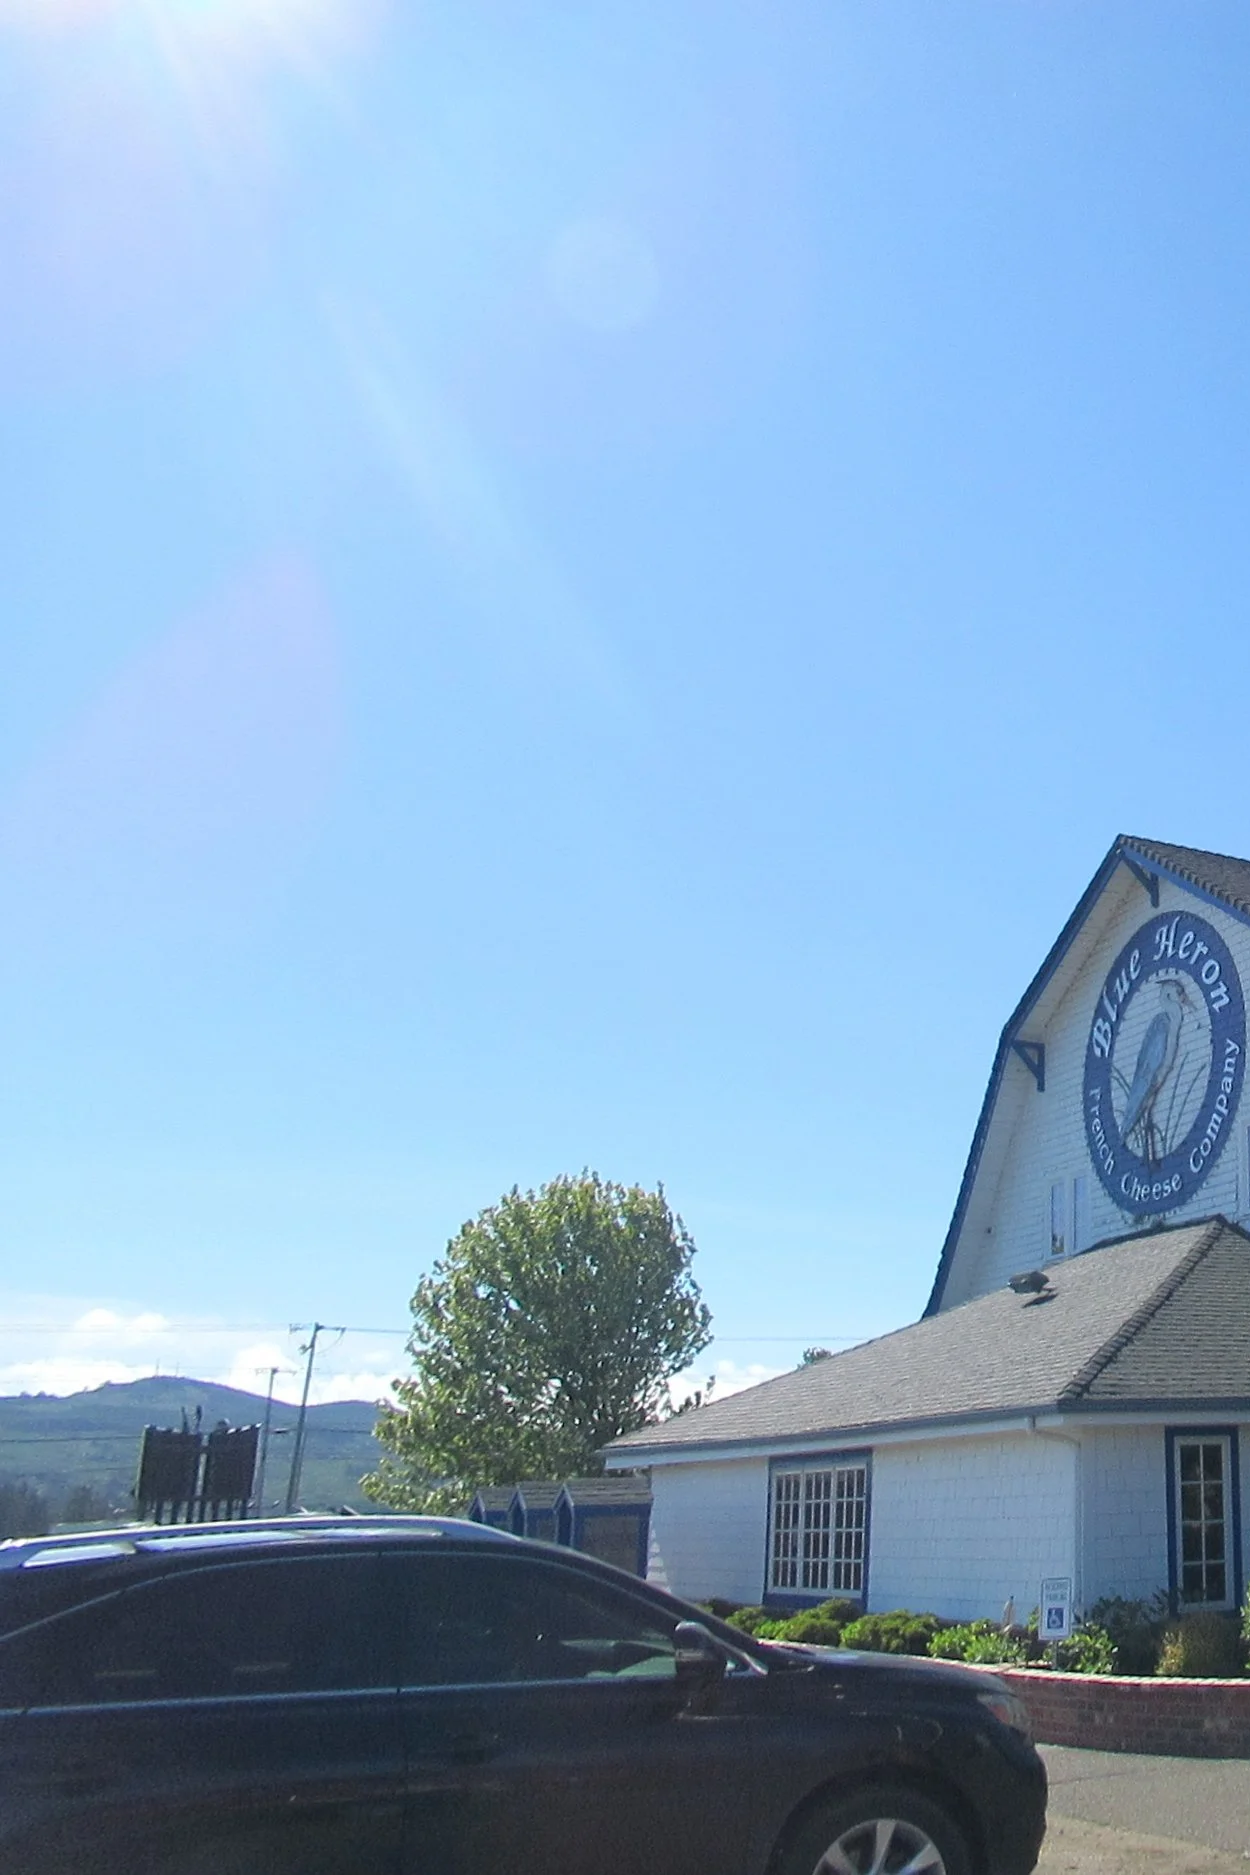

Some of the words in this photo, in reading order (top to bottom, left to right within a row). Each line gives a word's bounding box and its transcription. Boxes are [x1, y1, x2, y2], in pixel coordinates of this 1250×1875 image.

[1092, 948, 1141, 1059] Blue
[1153, 915, 1231, 1014] Heron
[1088, 1086, 1115, 1176] French
[1120, 1171, 1183, 1202] Cheese
[1189, 1038, 1240, 1174] Company
